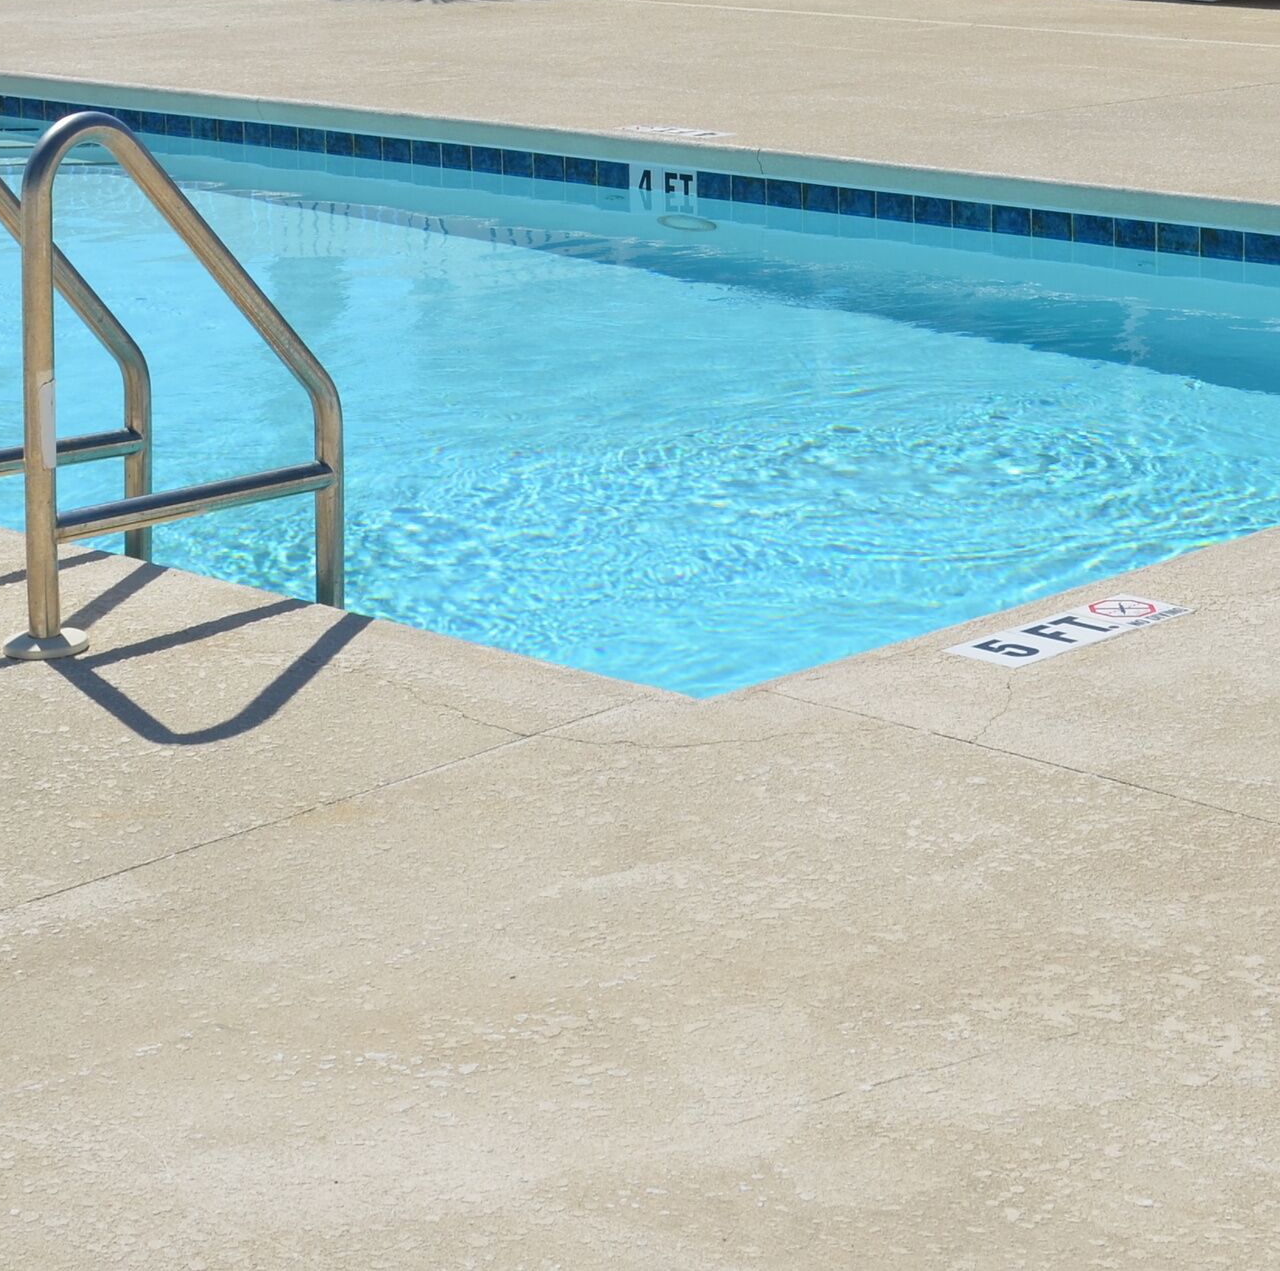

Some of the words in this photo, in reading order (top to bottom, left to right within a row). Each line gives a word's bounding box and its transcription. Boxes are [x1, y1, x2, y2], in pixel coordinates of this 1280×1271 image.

[664, 171, 694, 196] FT
[972, 638, 1040, 657] 5
[1020, 615, 1121, 644] FT.
